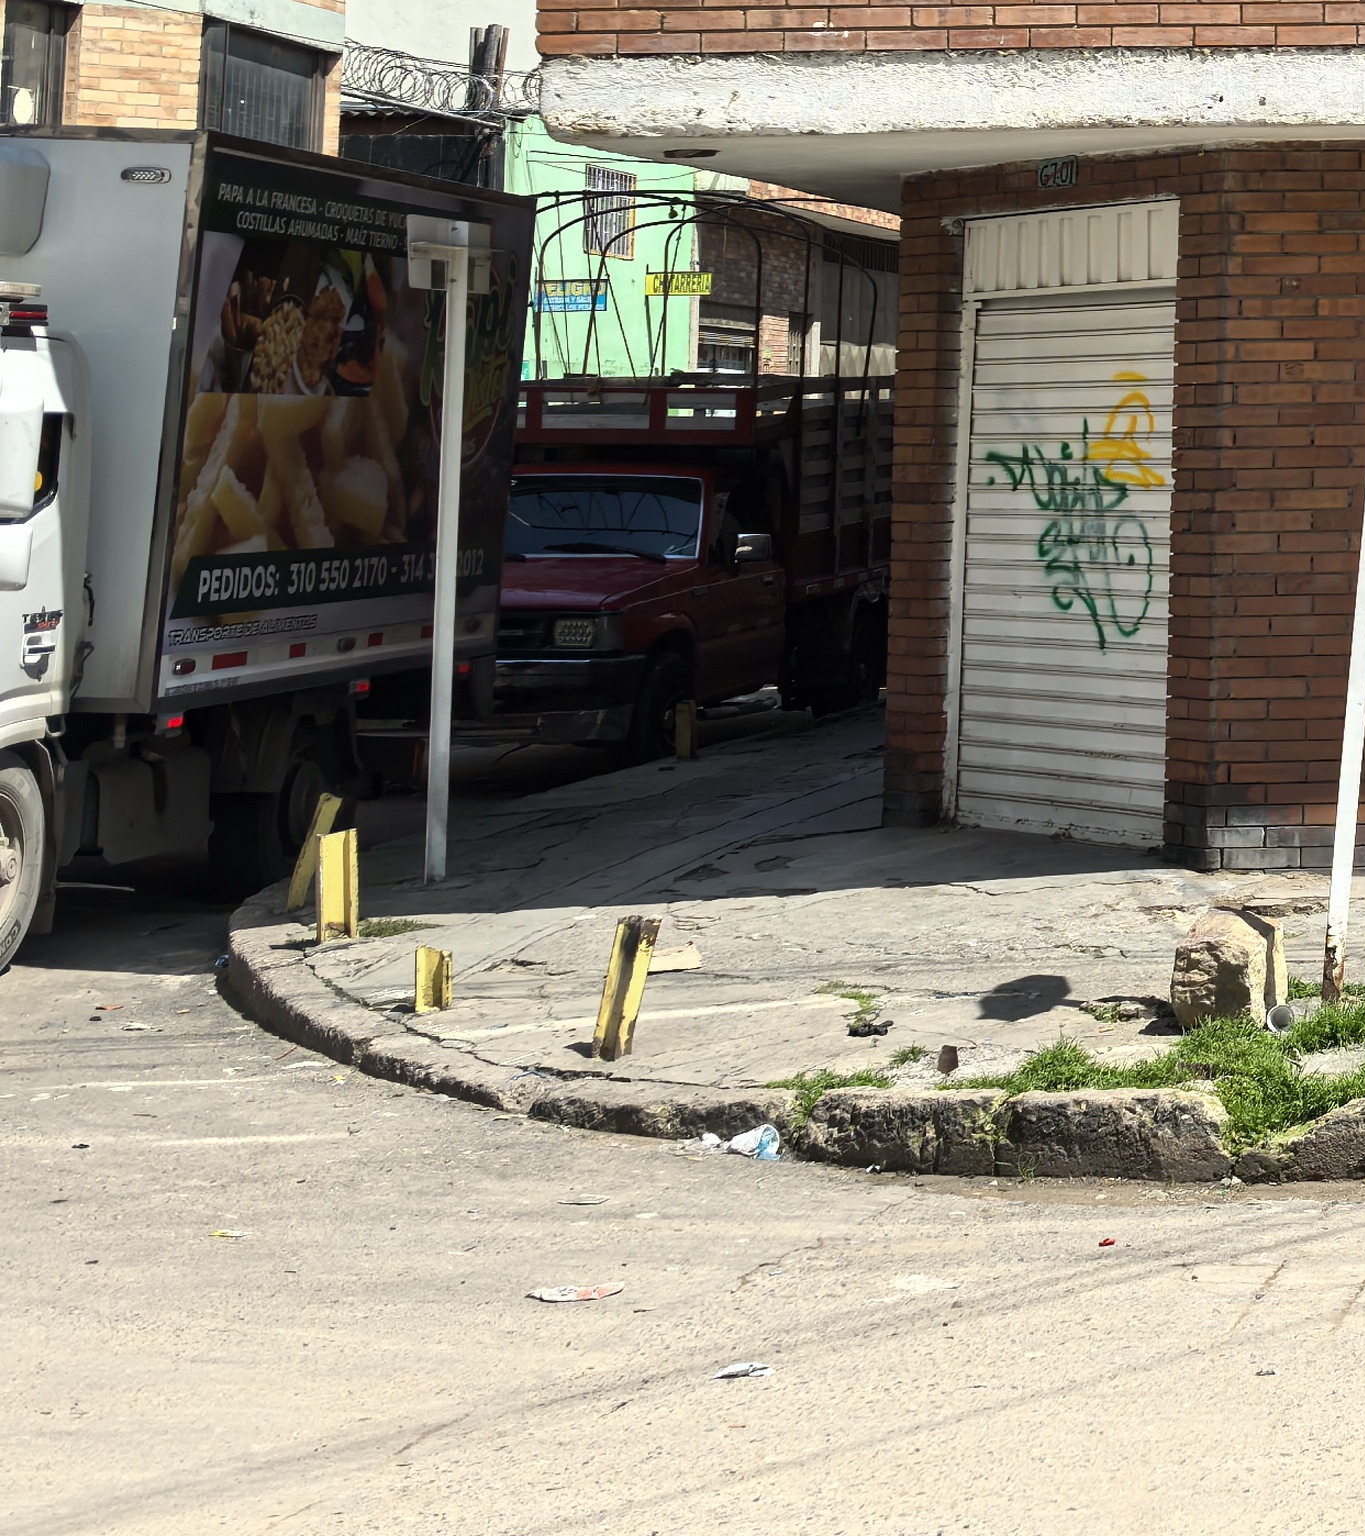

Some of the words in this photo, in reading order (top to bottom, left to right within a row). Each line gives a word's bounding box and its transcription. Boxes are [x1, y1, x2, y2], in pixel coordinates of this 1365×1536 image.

[218, 183, 243, 203] PAPA
[246, 187, 253, 205] A
[256, 189, 268, 207] LA
[271, 192, 317, 215] FRANCESA
[325, 201, 374, 223] CROQUETAS
[375, 210, 387, 226] DE
[388, 211, 407, 229] YUC
[236, 211, 287, 234] COSTILLAS
[287, 218, 339, 241] AHUMADAS
[369, 231, 398, 250] TIERNO
[197, 563, 281, 603] PEDIDOS:
[287, 561, 316, 595] 310
[318, 559, 349, 591] 550
[352, 556, 388, 589] 2170
[401, 552, 425, 583] 314
